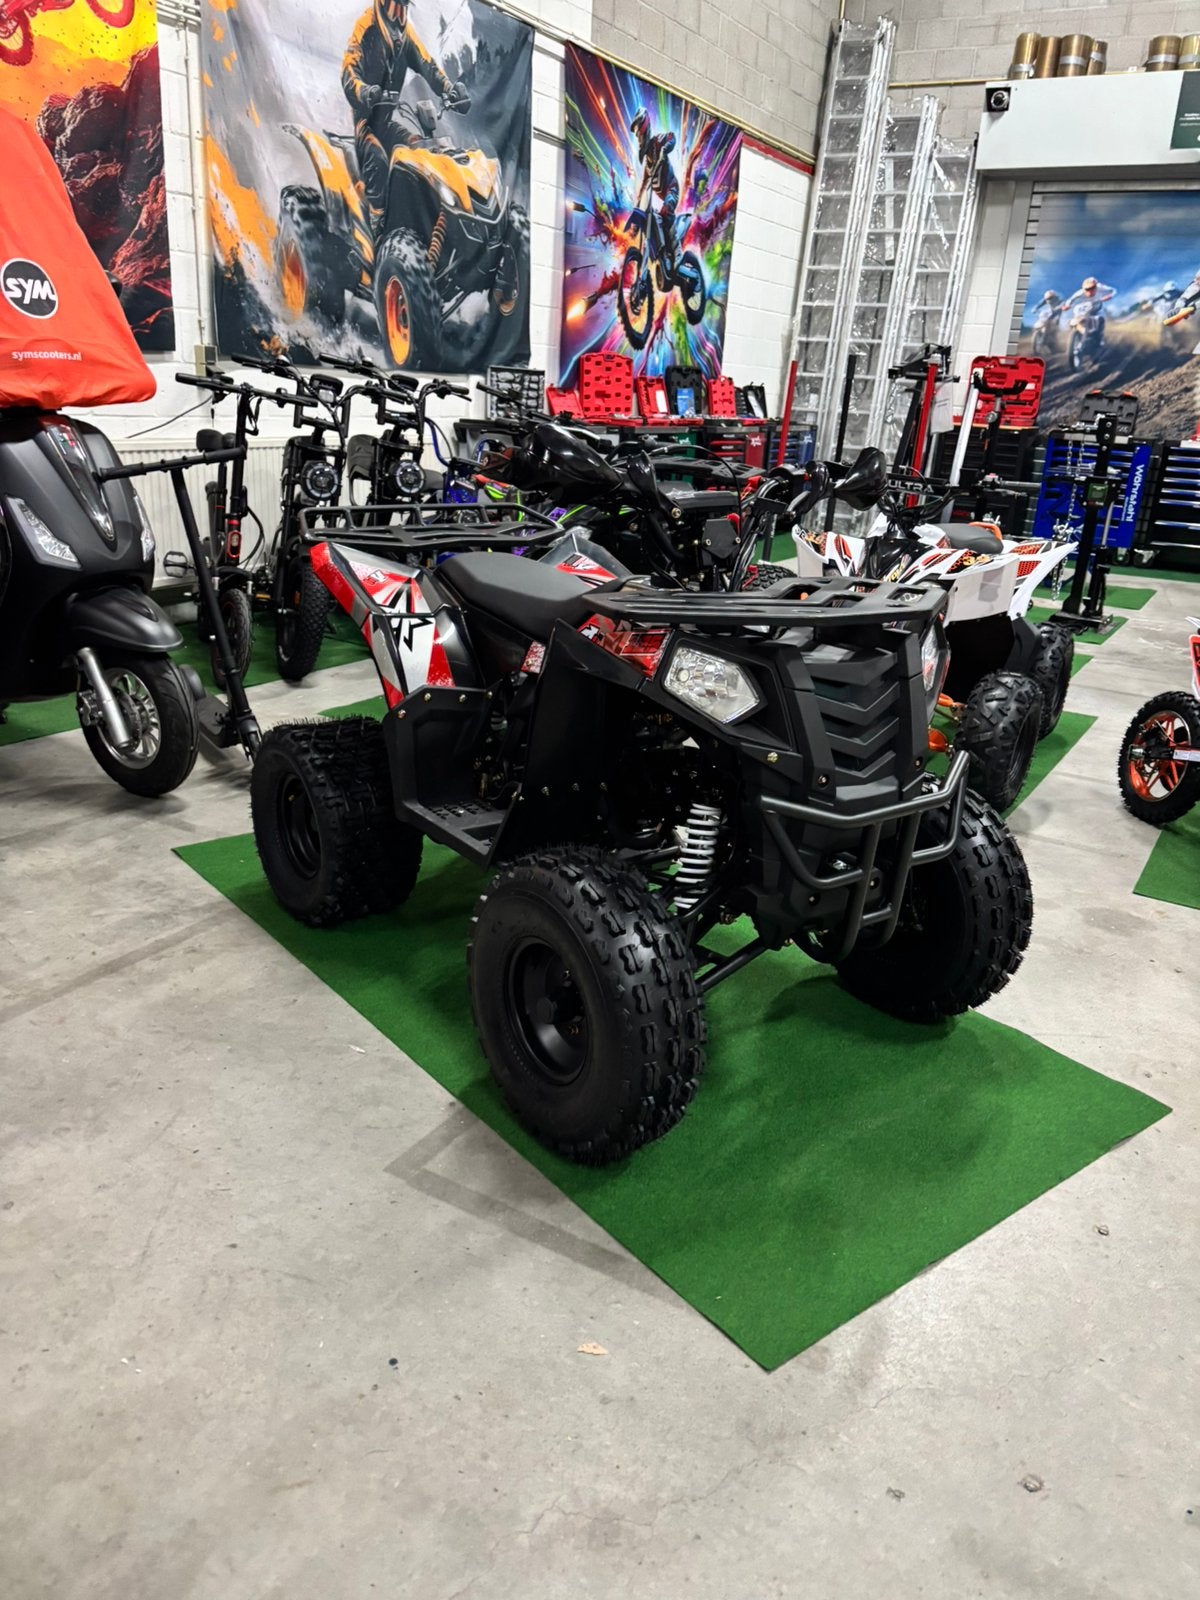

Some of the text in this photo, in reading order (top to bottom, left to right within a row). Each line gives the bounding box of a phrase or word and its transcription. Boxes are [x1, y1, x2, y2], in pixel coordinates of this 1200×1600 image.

[5, 277, 57, 304] SYM
[11, 350, 82, 361] symscooters.nl
[888, 479, 934, 493] ULTRA
